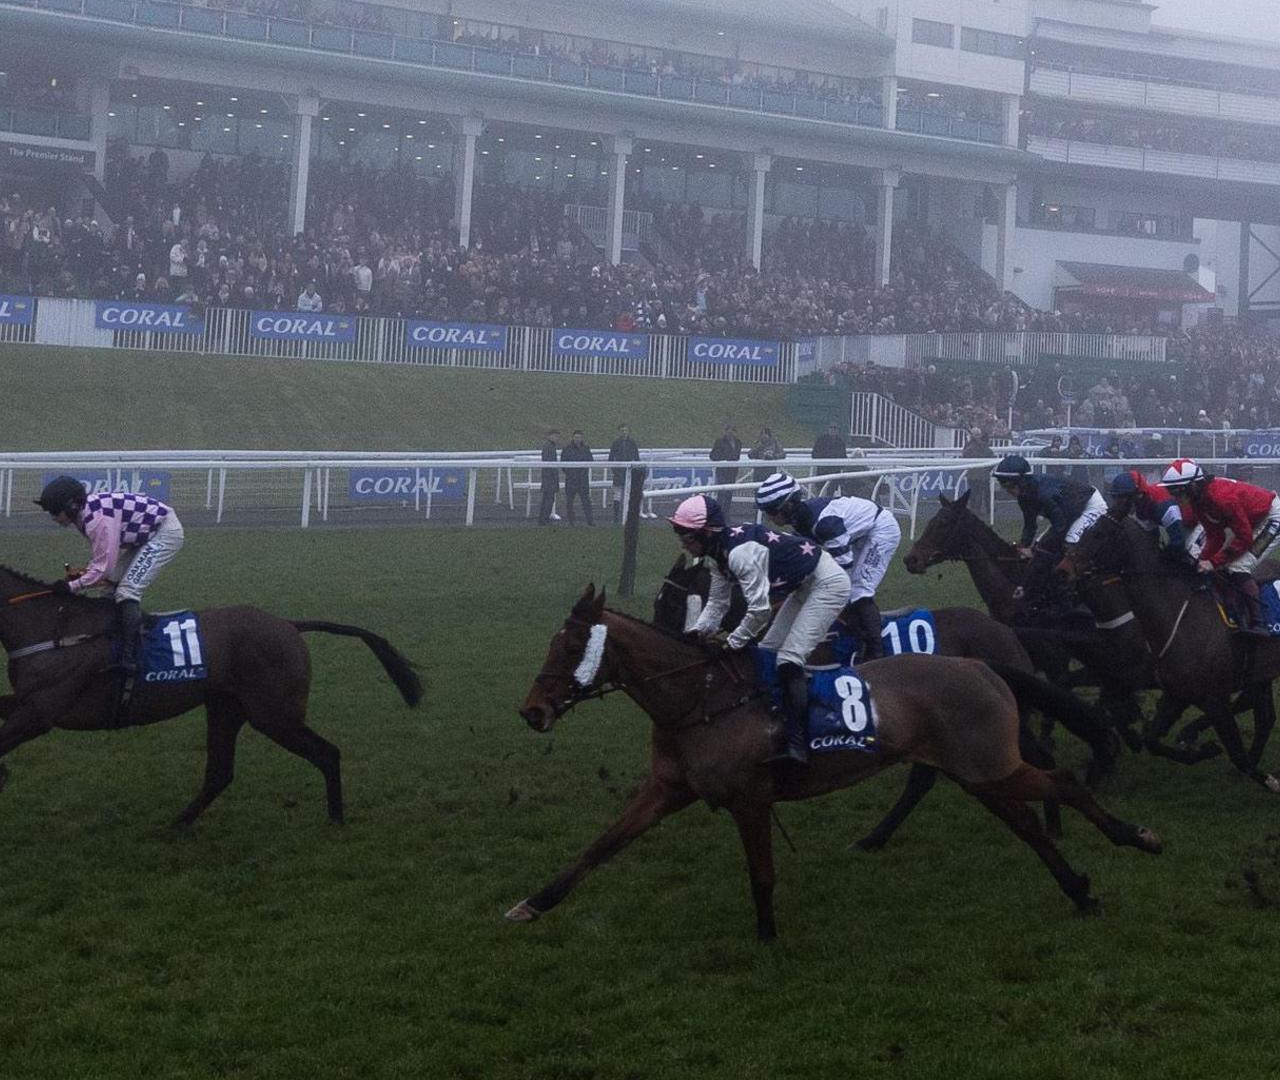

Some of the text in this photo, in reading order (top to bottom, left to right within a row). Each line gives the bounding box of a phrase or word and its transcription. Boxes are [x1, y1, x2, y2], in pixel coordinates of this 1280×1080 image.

[8, 147, 84, 163] The Premier Stand
[102, 307, 185, 327] CORAL
[257, 317, 336, 336] CORAL
[412, 326, 488, 345] CORAL
[558, 334, 630, 353] CORAL
[694, 342, 762, 361] CORAL
[81, 479, 146, 496] RAL
[355, 476, 443, 494] CORAL
[162, 619, 203, 667] 11
[881, 619, 935, 655] 10
[145, 669, 197, 682] CORAL
[834, 675, 868, 732] 8
[810, 734, 867, 749] CORAL
